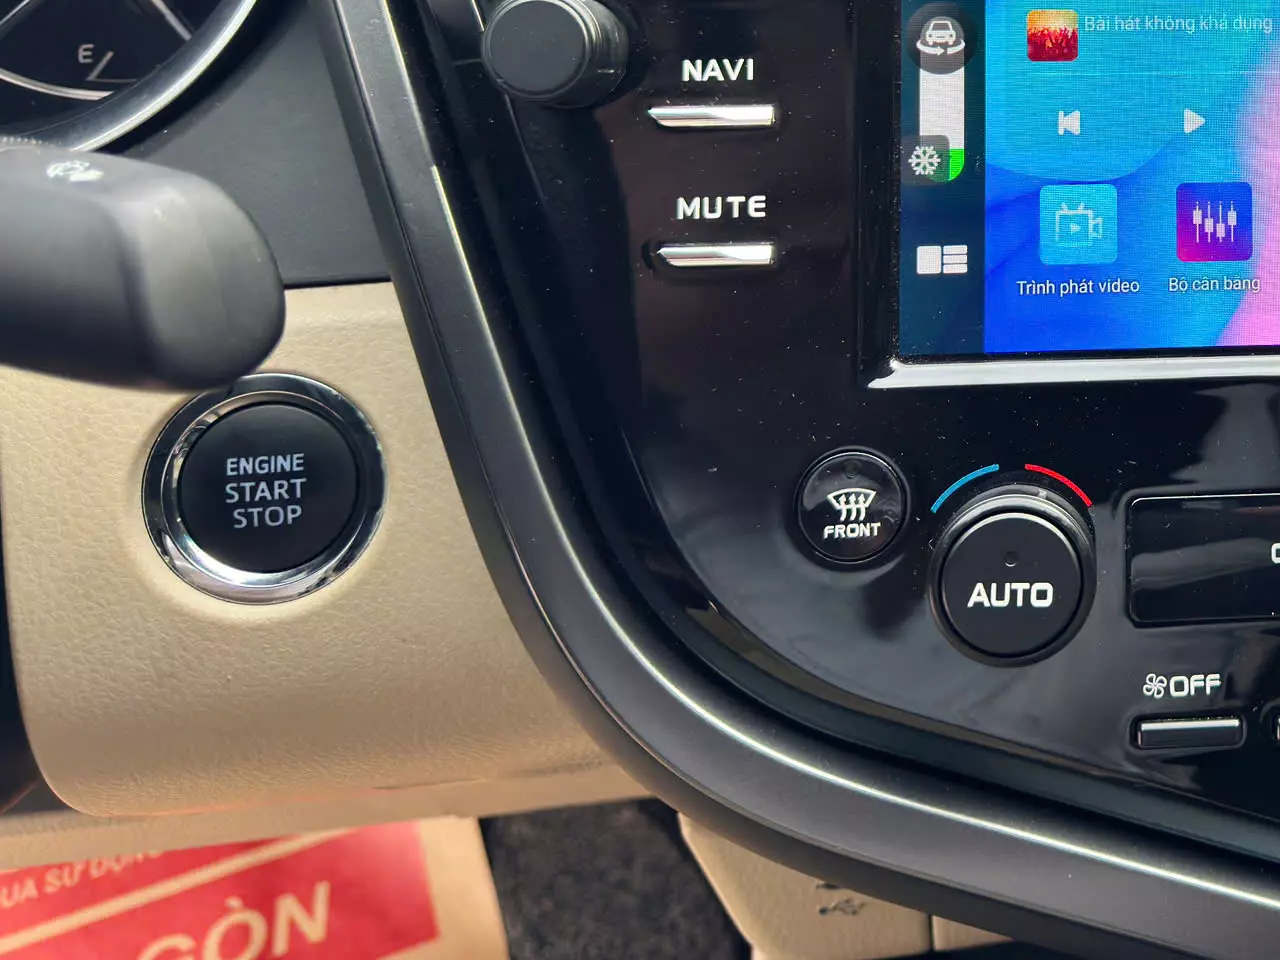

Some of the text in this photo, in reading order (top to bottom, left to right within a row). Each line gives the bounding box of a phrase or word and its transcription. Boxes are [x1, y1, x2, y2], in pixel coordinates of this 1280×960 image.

[78, 45, 94, 63] E
[682, 59, 754, 81] NAVI
[676, 195, 766, 219] MUTE
[1016, 277, 1140, 297] Trình phát video
[226, 454, 305, 476] ENGINE
[225, 479, 307, 503] START
[233, 506, 302, 528] STOP
[823, 522, 881, 539] FRONT
[967, 582, 1053, 608] AUTO
[1169, 674, 1222, 697] OFF
